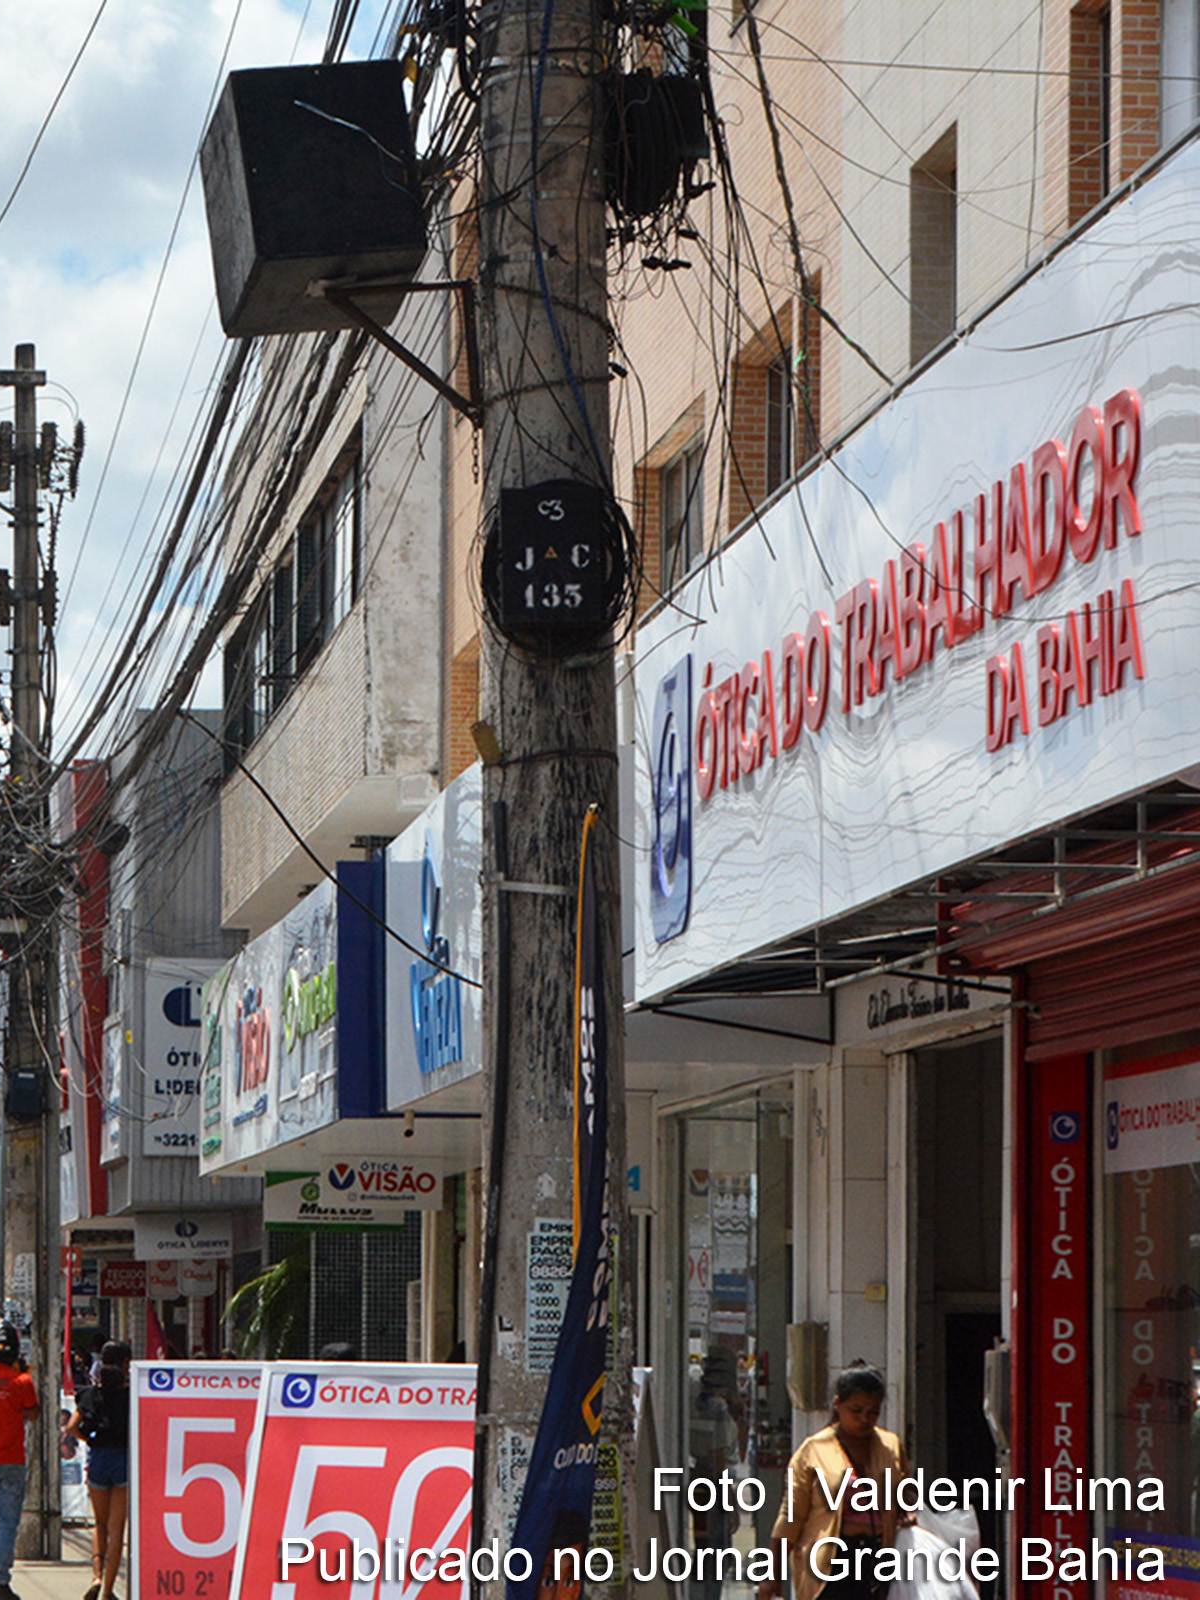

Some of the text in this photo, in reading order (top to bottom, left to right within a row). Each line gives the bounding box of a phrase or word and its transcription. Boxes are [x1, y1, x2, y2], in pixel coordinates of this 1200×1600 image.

[524, 583, 583, 608] 135
[696, 389, 1142, 800] ÓTICA DO TRABALHADOR
[985, 578, 1144, 753] DA BAHIA
[167, 1047, 200, 1066] ÓTI
[357, 1166, 437, 1193] VISÃO
[360, 1161, 399, 1172] ÓTICA
[1051, 1157, 1074, 1280] ÓTICA
[1053, 1319, 1075, 1364] DO
[177, 1372, 233, 1390] ÓTICA
[319, 1380, 391, 1405] ÓTICA
[397, 1386, 434, 1405] DO
[156, 1570, 185, 1596] NO
